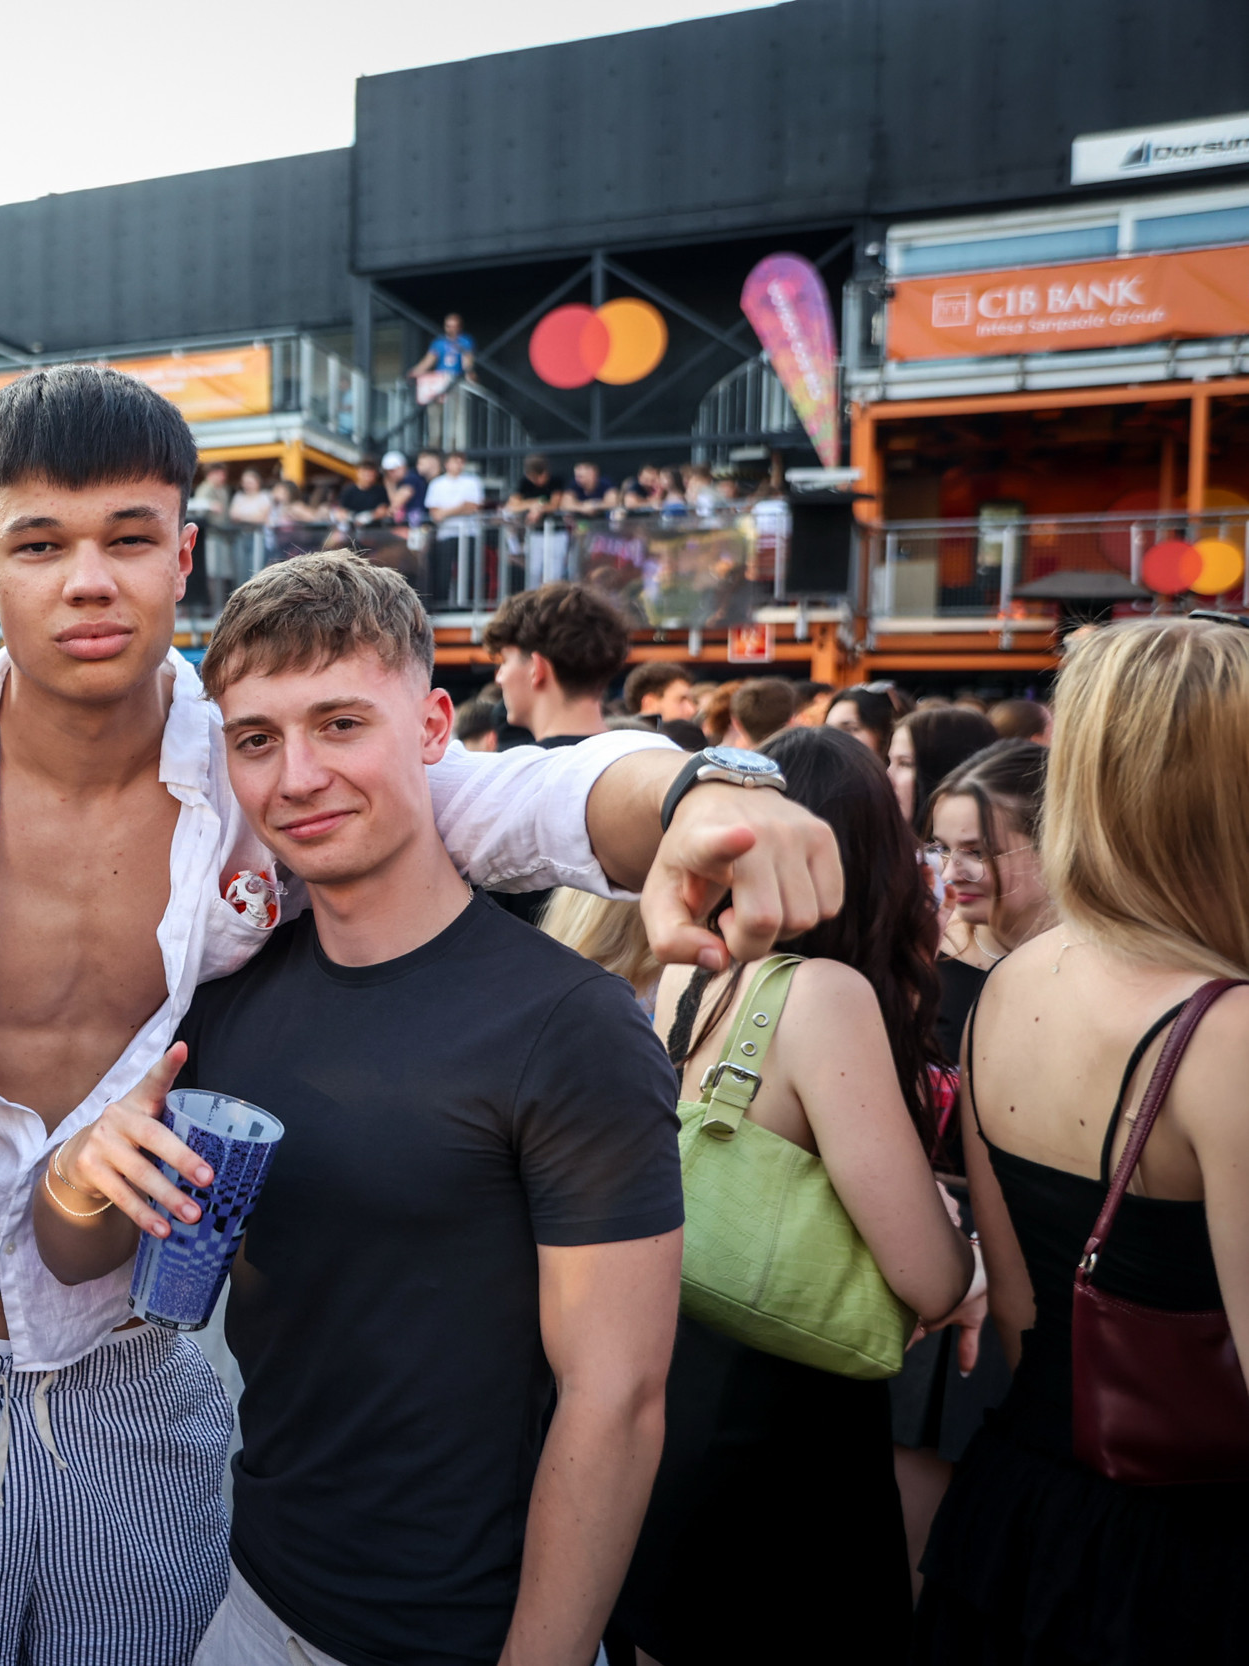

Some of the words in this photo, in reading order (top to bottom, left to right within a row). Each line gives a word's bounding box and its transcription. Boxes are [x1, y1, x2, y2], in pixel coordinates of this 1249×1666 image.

[977, 283, 1042, 318] CIB
[1046, 273, 1147, 314] BANK
[976, 318, 1025, 337] Intesa
[1027, 309, 1106, 334] Sanpaolo
[1109, 303, 1167, 327] Group
